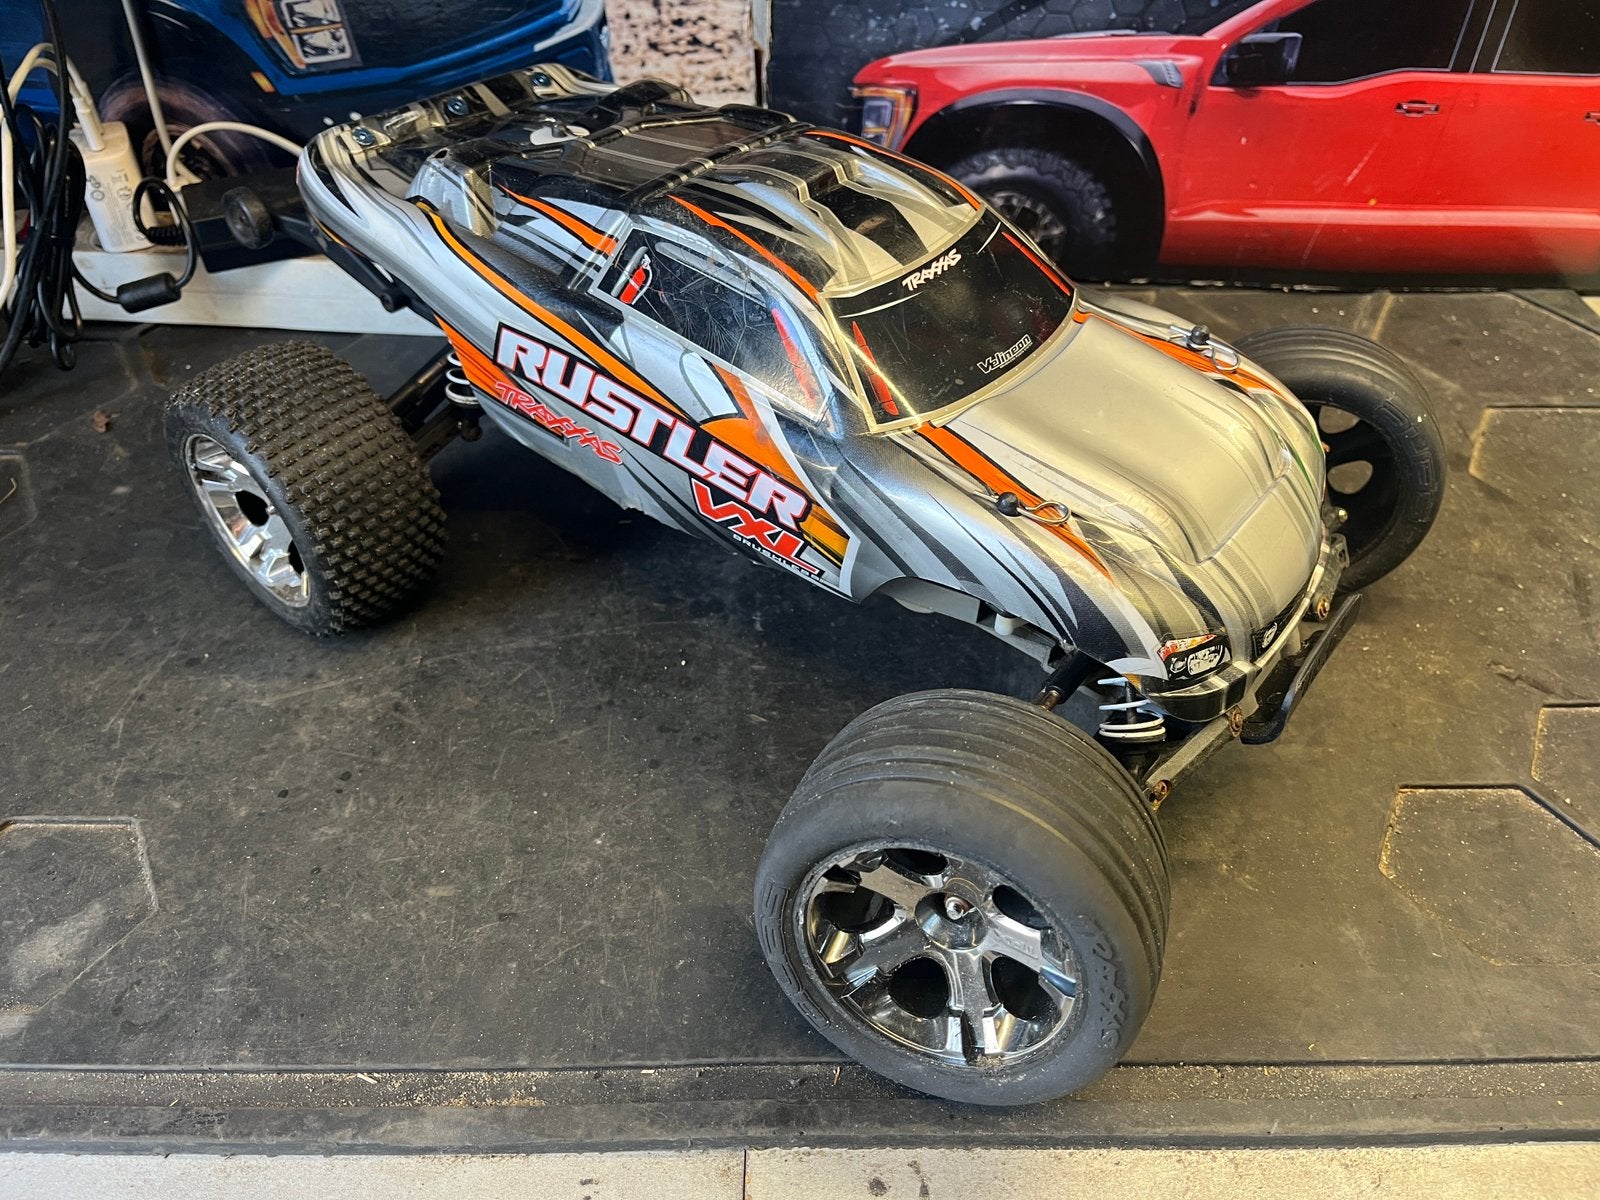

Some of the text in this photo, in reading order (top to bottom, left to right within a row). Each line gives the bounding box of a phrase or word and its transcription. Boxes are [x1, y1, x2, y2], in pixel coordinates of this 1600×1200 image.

[901, 248, 962, 292] TRAXXAS
[977, 334, 1032, 374] Velineon
[494, 381, 623, 465] TRAXXAS
[496, 327, 810, 532] RUSTLER
[691, 478, 821, 575] VXL
